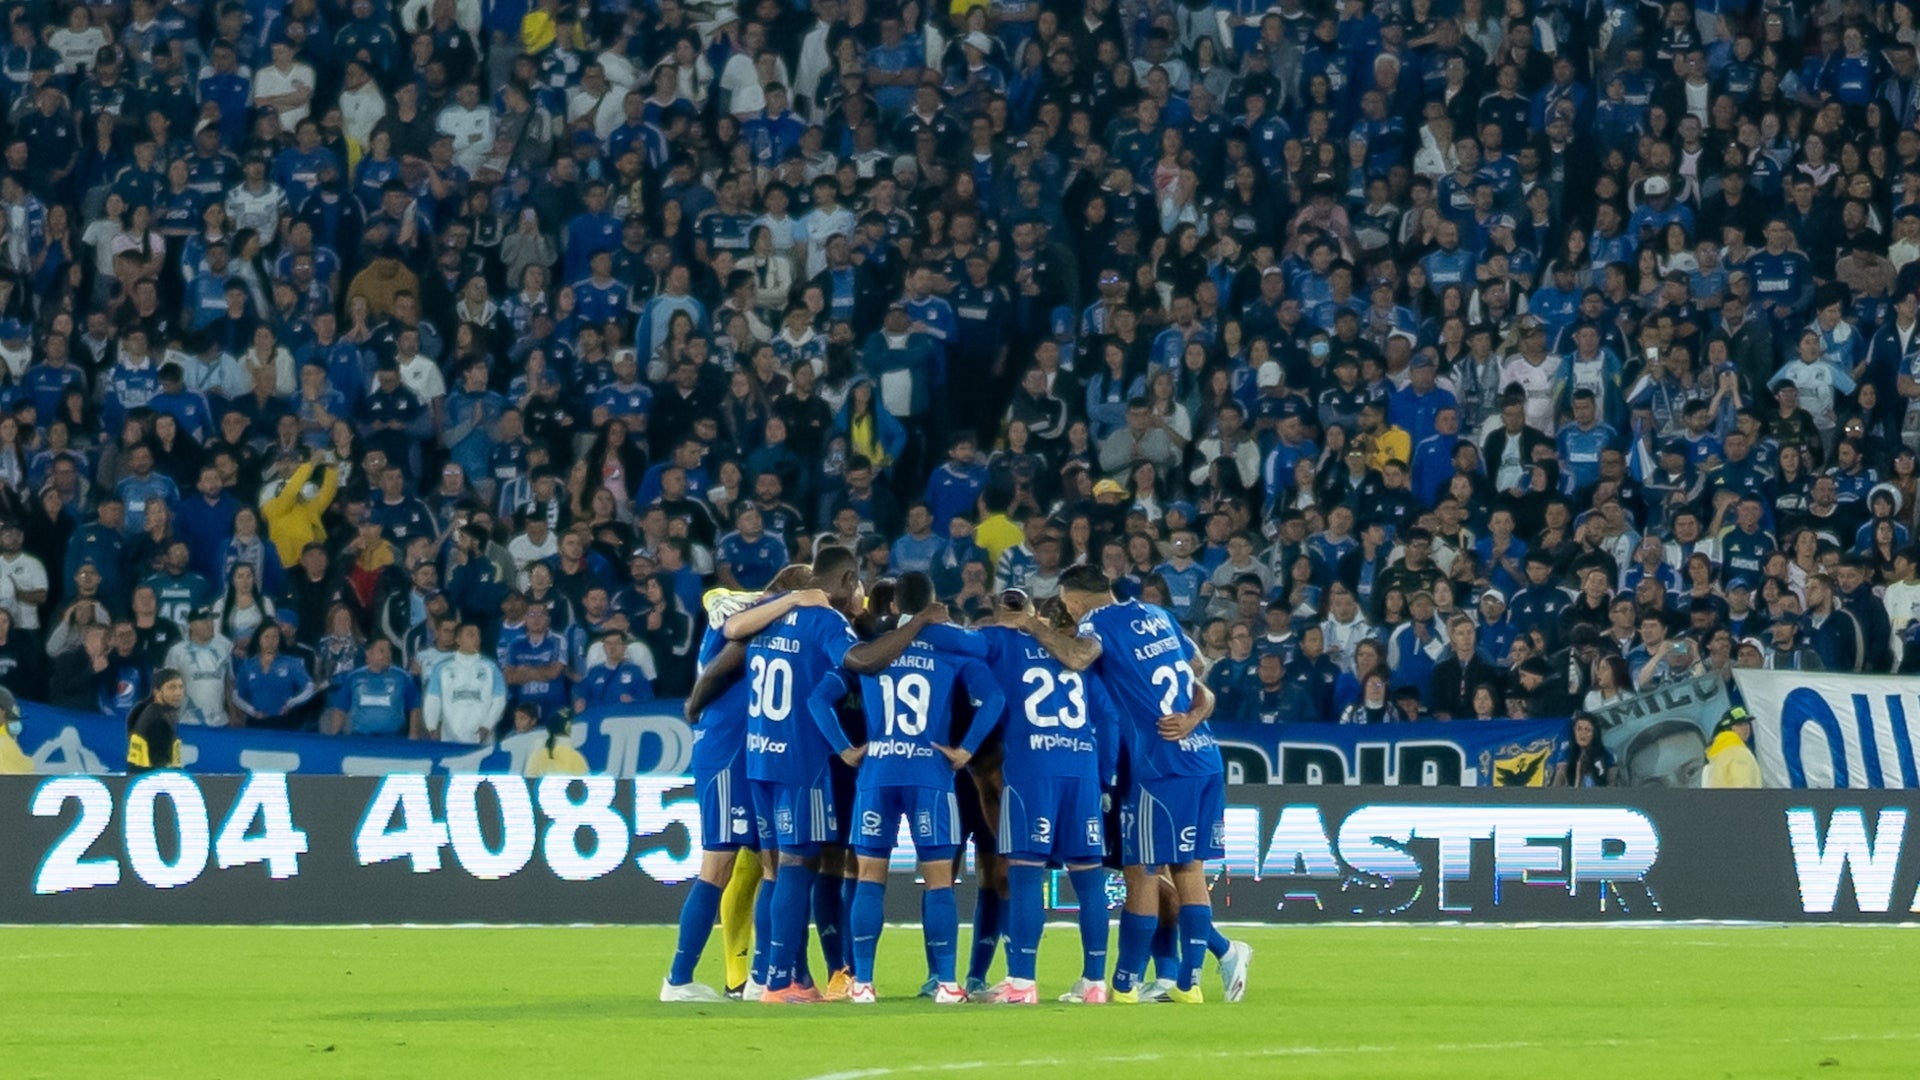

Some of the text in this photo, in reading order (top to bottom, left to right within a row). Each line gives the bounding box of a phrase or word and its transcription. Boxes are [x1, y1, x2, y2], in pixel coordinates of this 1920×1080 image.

[748, 655, 792, 721] 30
[879, 673, 931, 736] 19
[1022, 667, 1086, 729] 23
[31, 770, 700, 894] 204 4085
[1786, 805, 1920, 913] W
